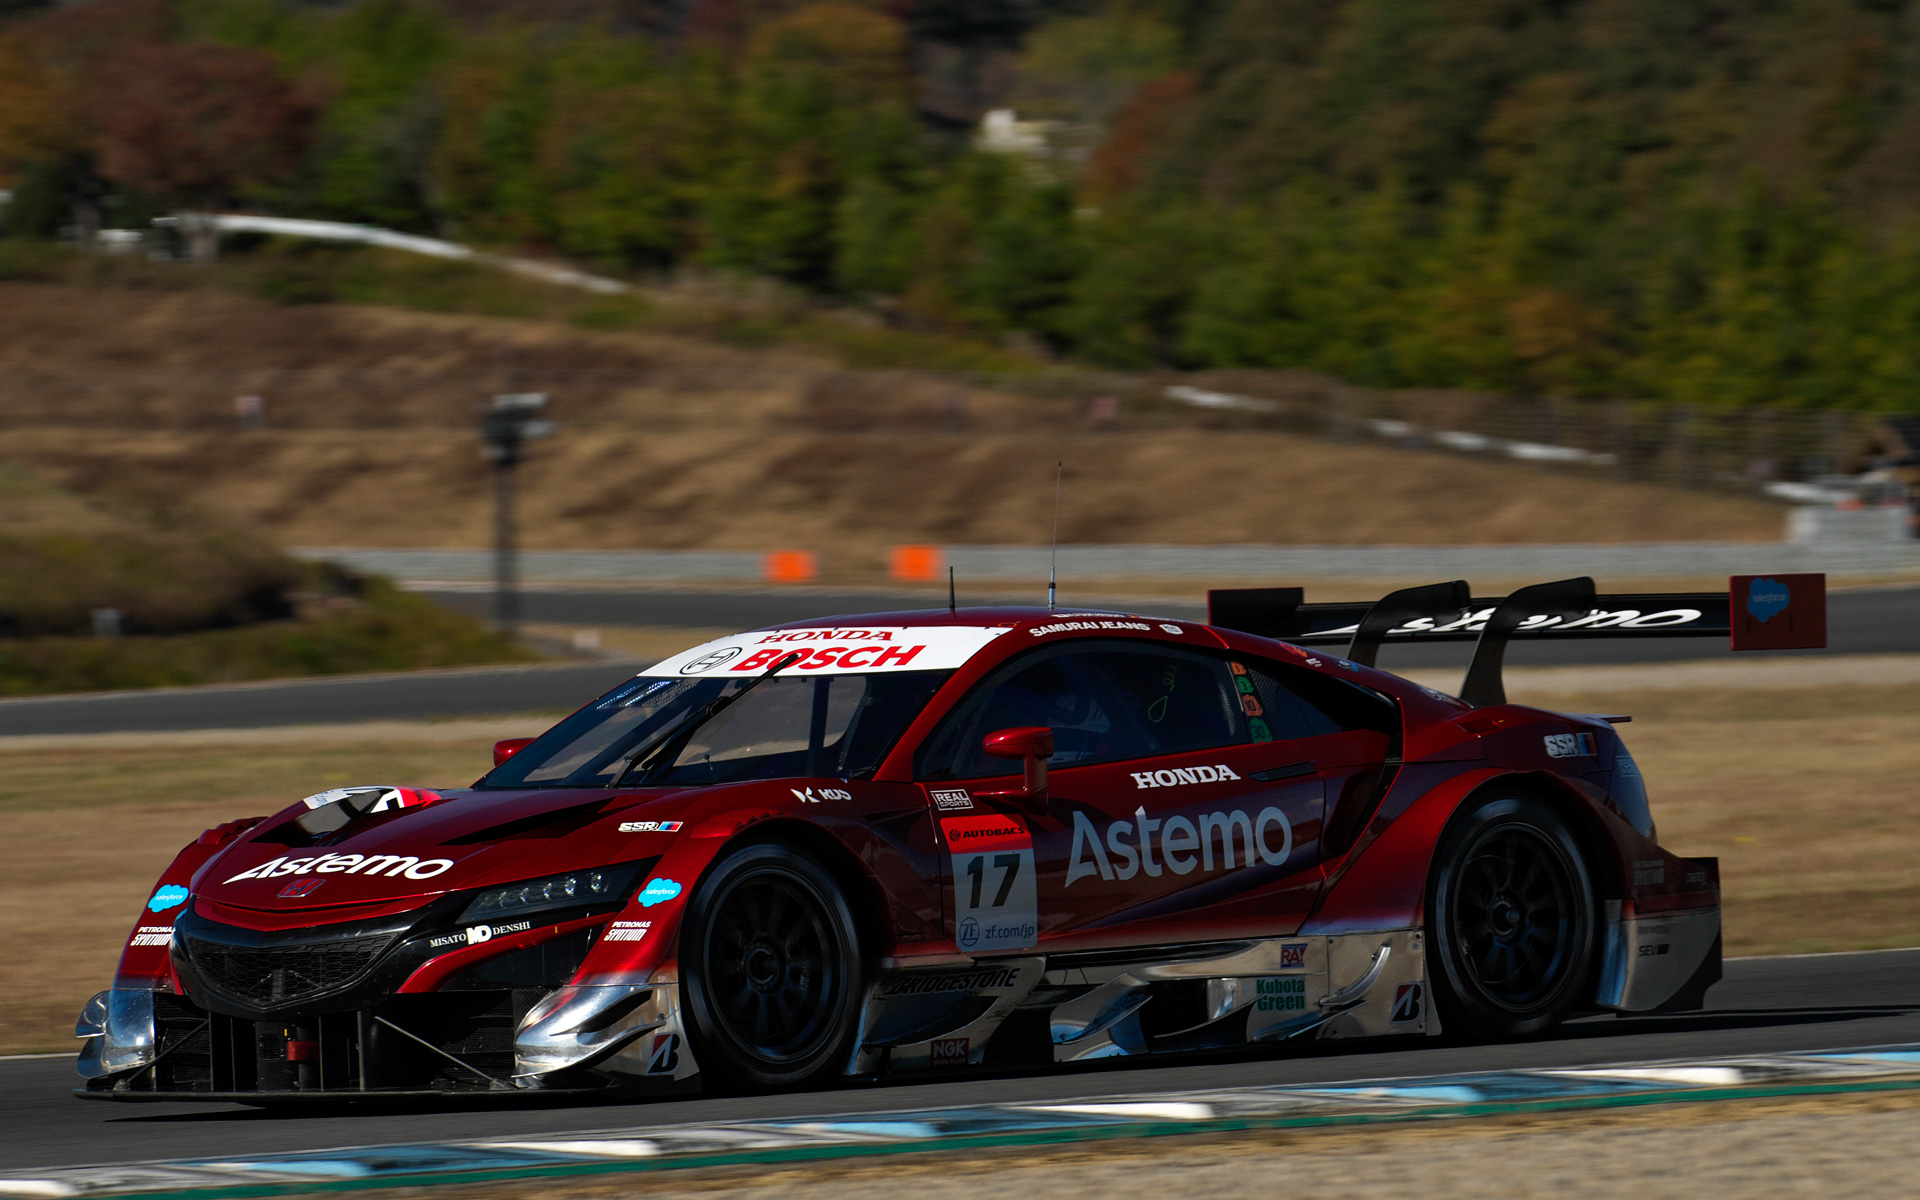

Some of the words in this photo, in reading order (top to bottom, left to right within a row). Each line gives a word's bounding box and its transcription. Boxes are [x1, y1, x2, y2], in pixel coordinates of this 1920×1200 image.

[1029, 621, 1100, 637] SAMURAI
[1099, 621, 1151, 632] JEANS
[755, 630, 893, 645] HONDA
[729, 645, 927, 671] BOSCH
[1543, 733, 1580, 758] SSR
[1130, 764, 1241, 789] HONDA
[934, 791, 969, 802] REAL
[940, 800, 970, 808] SPORTS
[618, 821, 659, 832] SSR
[963, 827, 1025, 838] AUTOBACS
[1065, 805, 1293, 888] Astemo
[222, 852, 455, 885] Astemo
[967, 853, 1021, 908] 17
[154, 893, 183, 902] salesforce
[645, 887, 676, 896] salesforce
[429, 933, 467, 948] MISATO
[492, 921, 531, 936] DENSHI
[604, 928, 648, 941] SYNTIUM
[985, 923, 1034, 939] zf.com/jp
[884, 968, 1021, 994] BRIDGESTONE
[1256, 979, 1306, 993] Kubota
[1257, 995, 1306, 1011] Green
[933, 1039, 967, 1057] NGK
